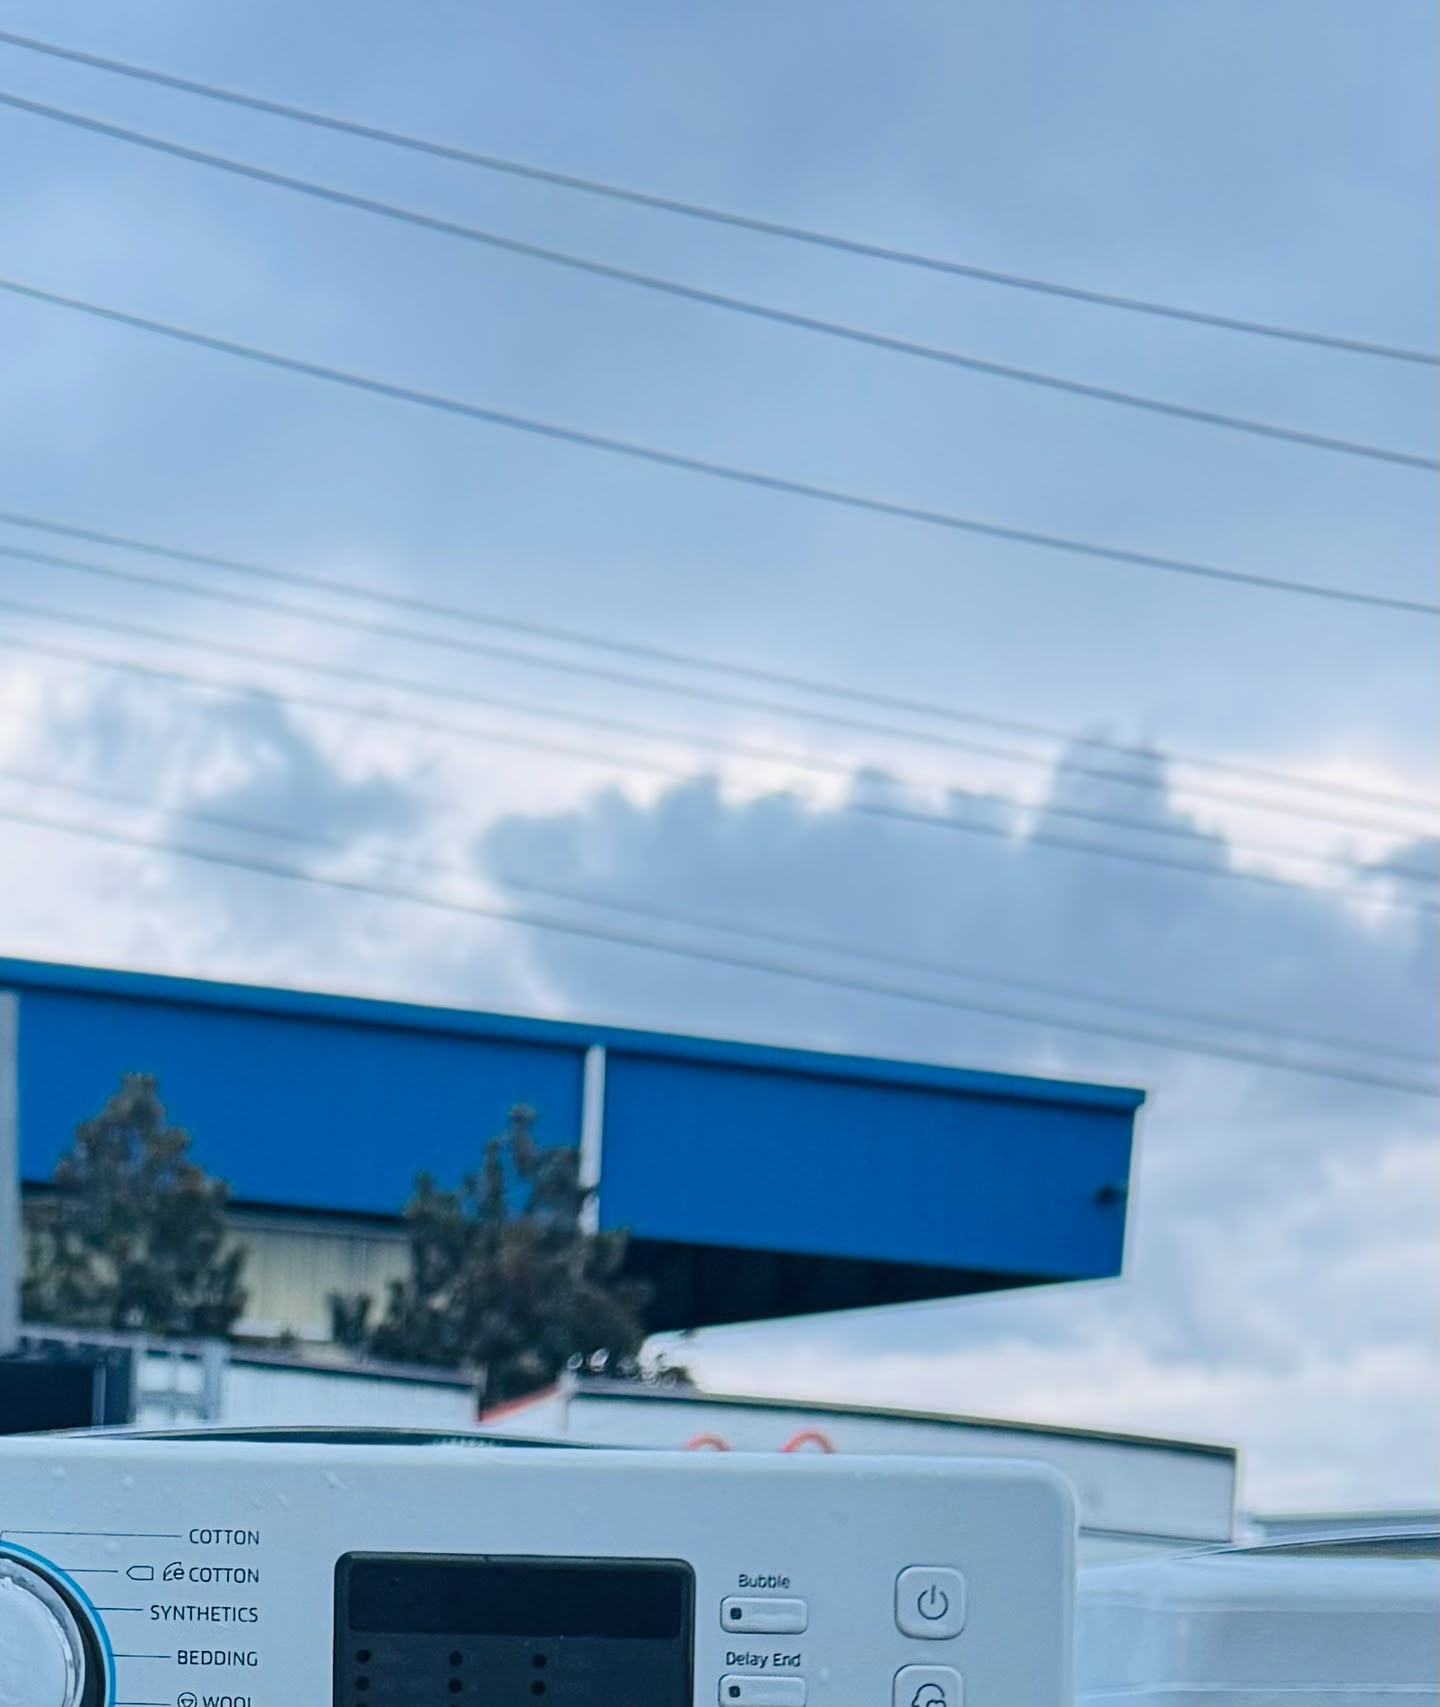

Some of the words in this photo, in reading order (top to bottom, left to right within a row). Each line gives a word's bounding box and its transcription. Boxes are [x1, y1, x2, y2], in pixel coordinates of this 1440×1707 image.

[188, 1528, 260, 1546] COTTON
[188, 1566, 260, 1584] COTTON
[738, 1573, 791, 1589] Bubble
[150, 1604, 259, 1624] SYNTHETICS
[177, 1649, 258, 1667] BEDDING
[726, 1651, 769, 1669] Delay
[773, 1653, 802, 1667] End
